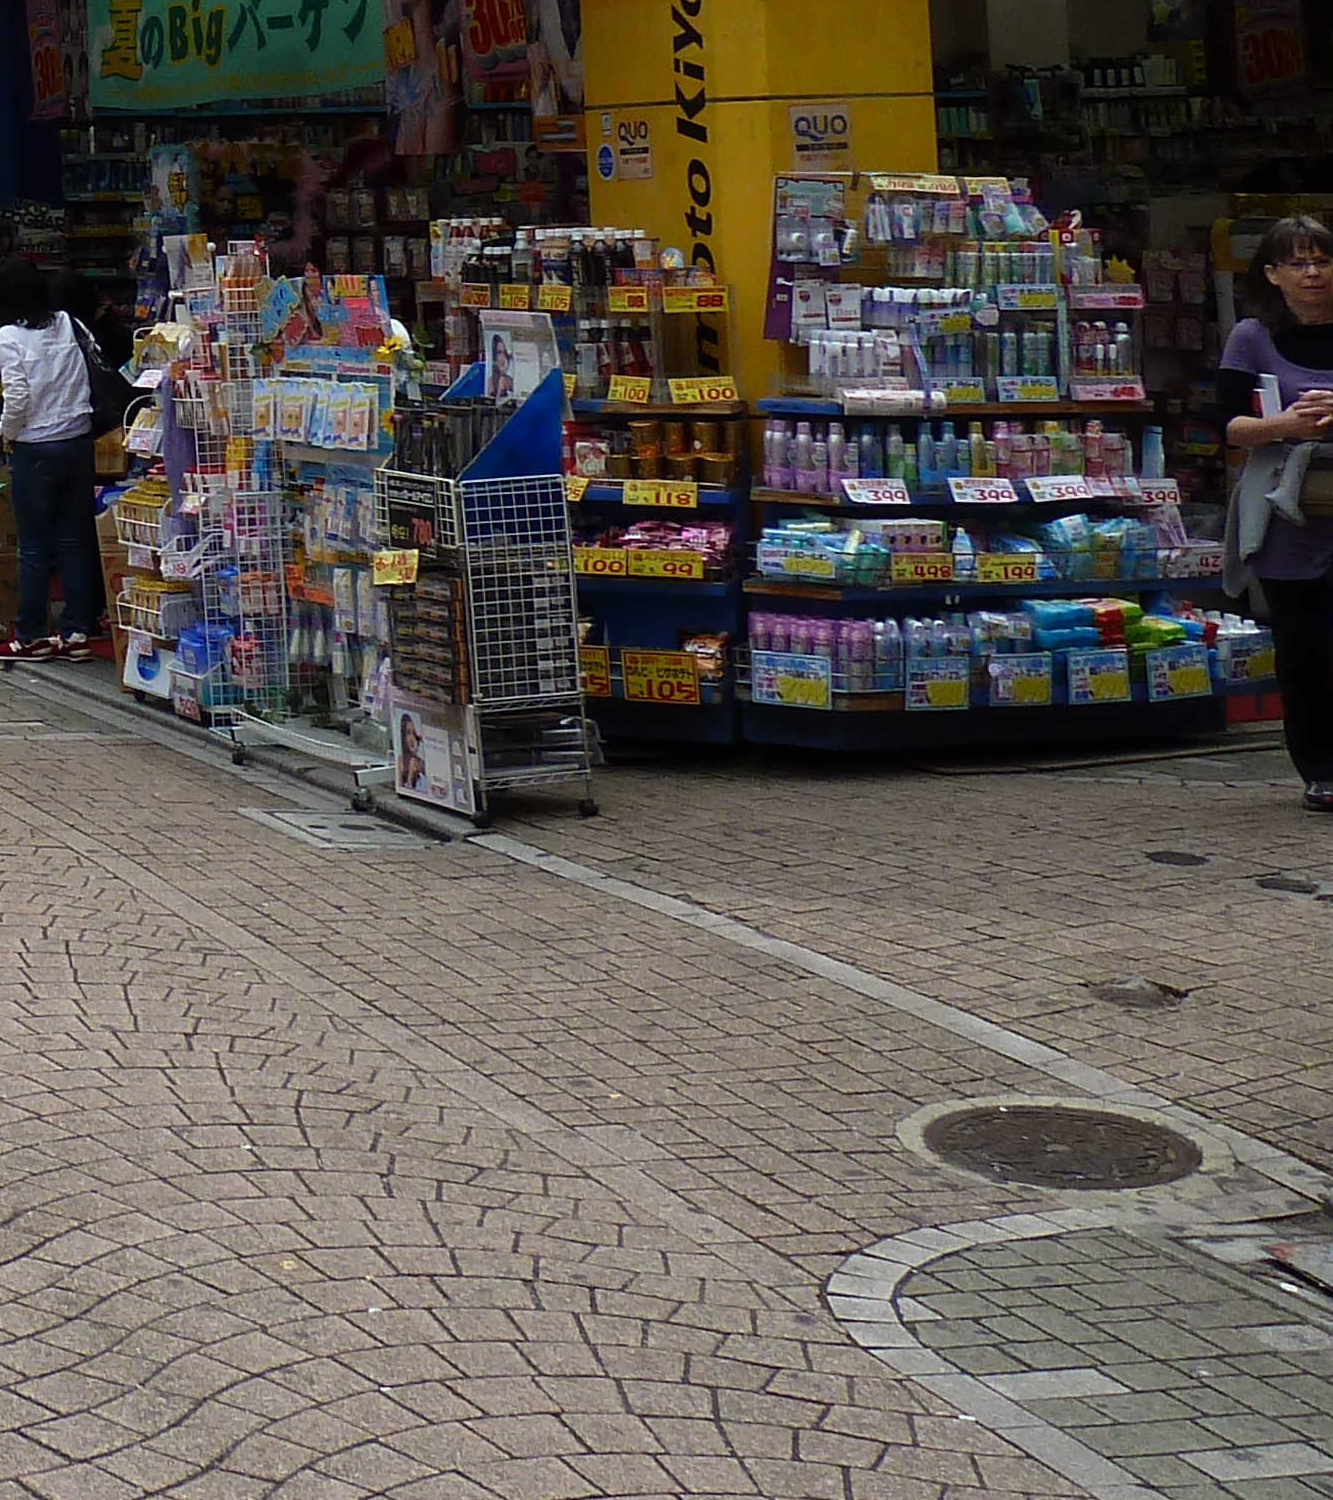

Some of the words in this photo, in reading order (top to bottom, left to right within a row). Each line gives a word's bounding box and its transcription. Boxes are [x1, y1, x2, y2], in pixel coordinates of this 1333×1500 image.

[618, 121, 649, 146] QUO
[622, 387, 646, 400] 100
[698, 388, 735, 400] 100
[654, 492, 692, 505] 118
[868, 489, 907, 502] 399
[974, 488, 1015, 502] 399
[1051, 485, 1088, 499] 399
[1142, 489, 1178, 504] 399
[583, 559, 624, 573] 100
[662, 562, 693, 576] 99
[914, 565, 952, 579] 498
[1003, 565, 1036, 580] 199
[644, 678, 697, 700] 105
